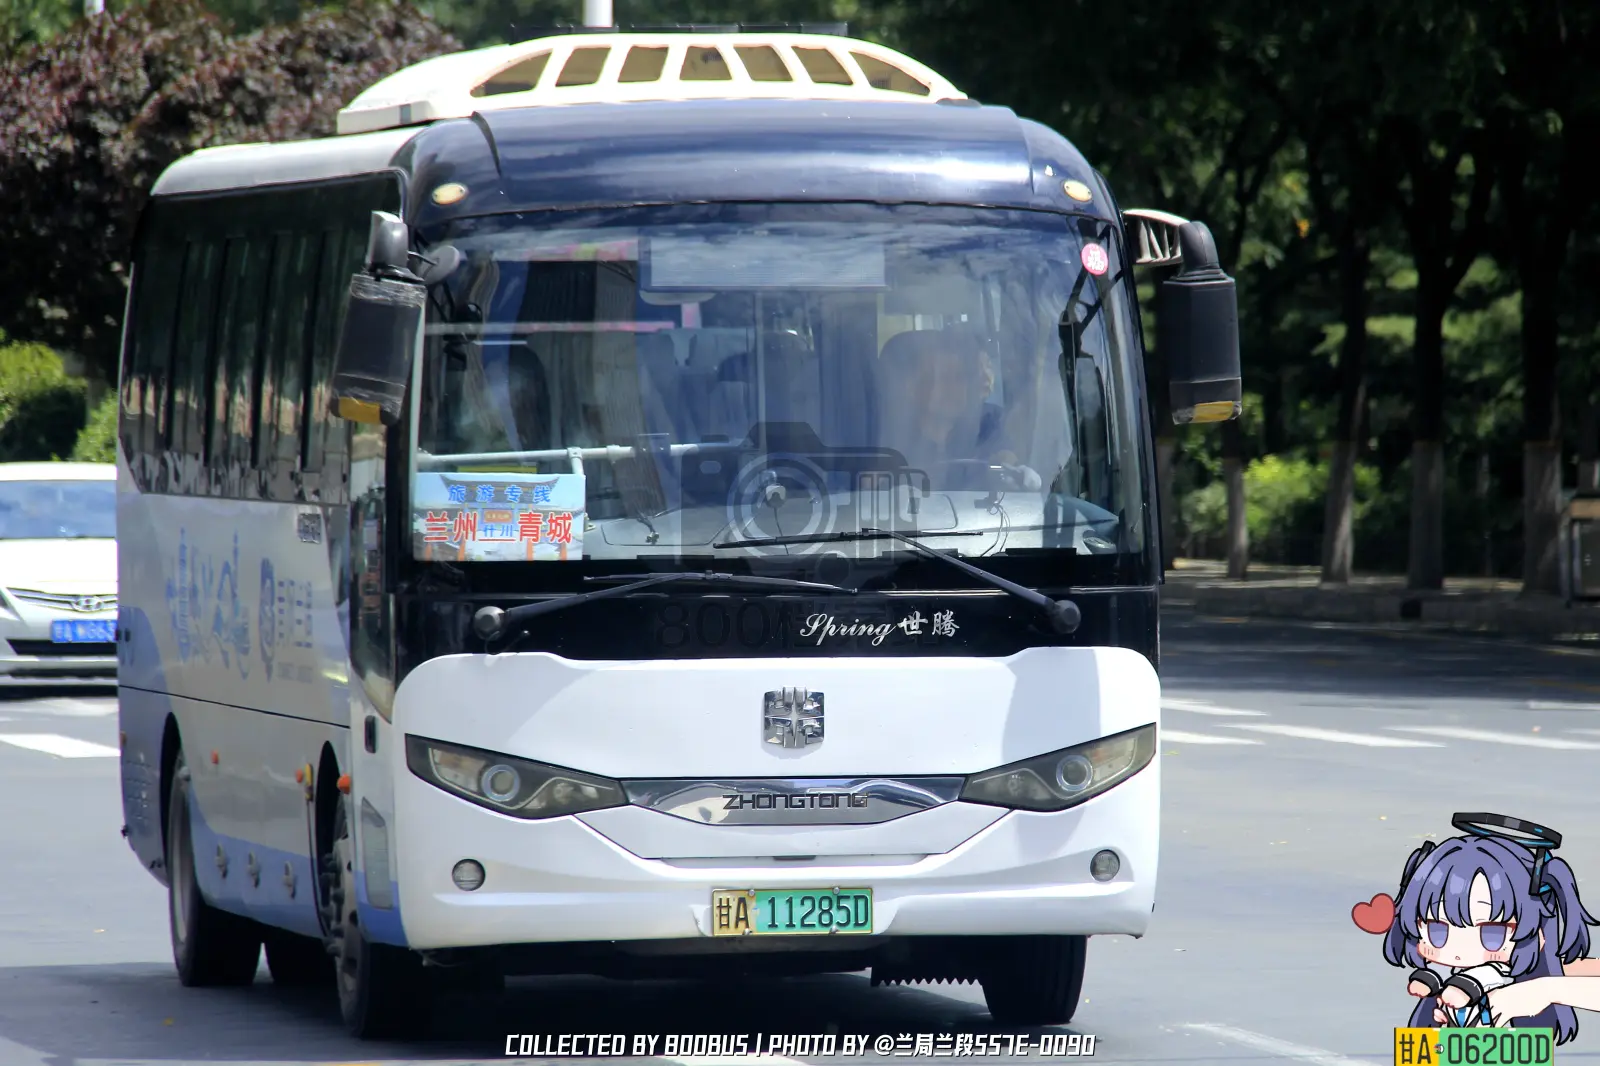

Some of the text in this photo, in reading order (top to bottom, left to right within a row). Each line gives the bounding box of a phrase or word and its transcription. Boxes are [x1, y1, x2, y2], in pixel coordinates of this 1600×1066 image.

[447, 485, 551, 503] 旅游专线
[424, 511, 477, 542] 兰州
[518, 512, 573, 543] 青城
[483, 525, 513, 537] 什川
[800, 609, 960, 646] Spring 世腾
[722, 793, 868, 810] ZHONGTONG
[716, 895, 869, 929] 甘A 11285D
